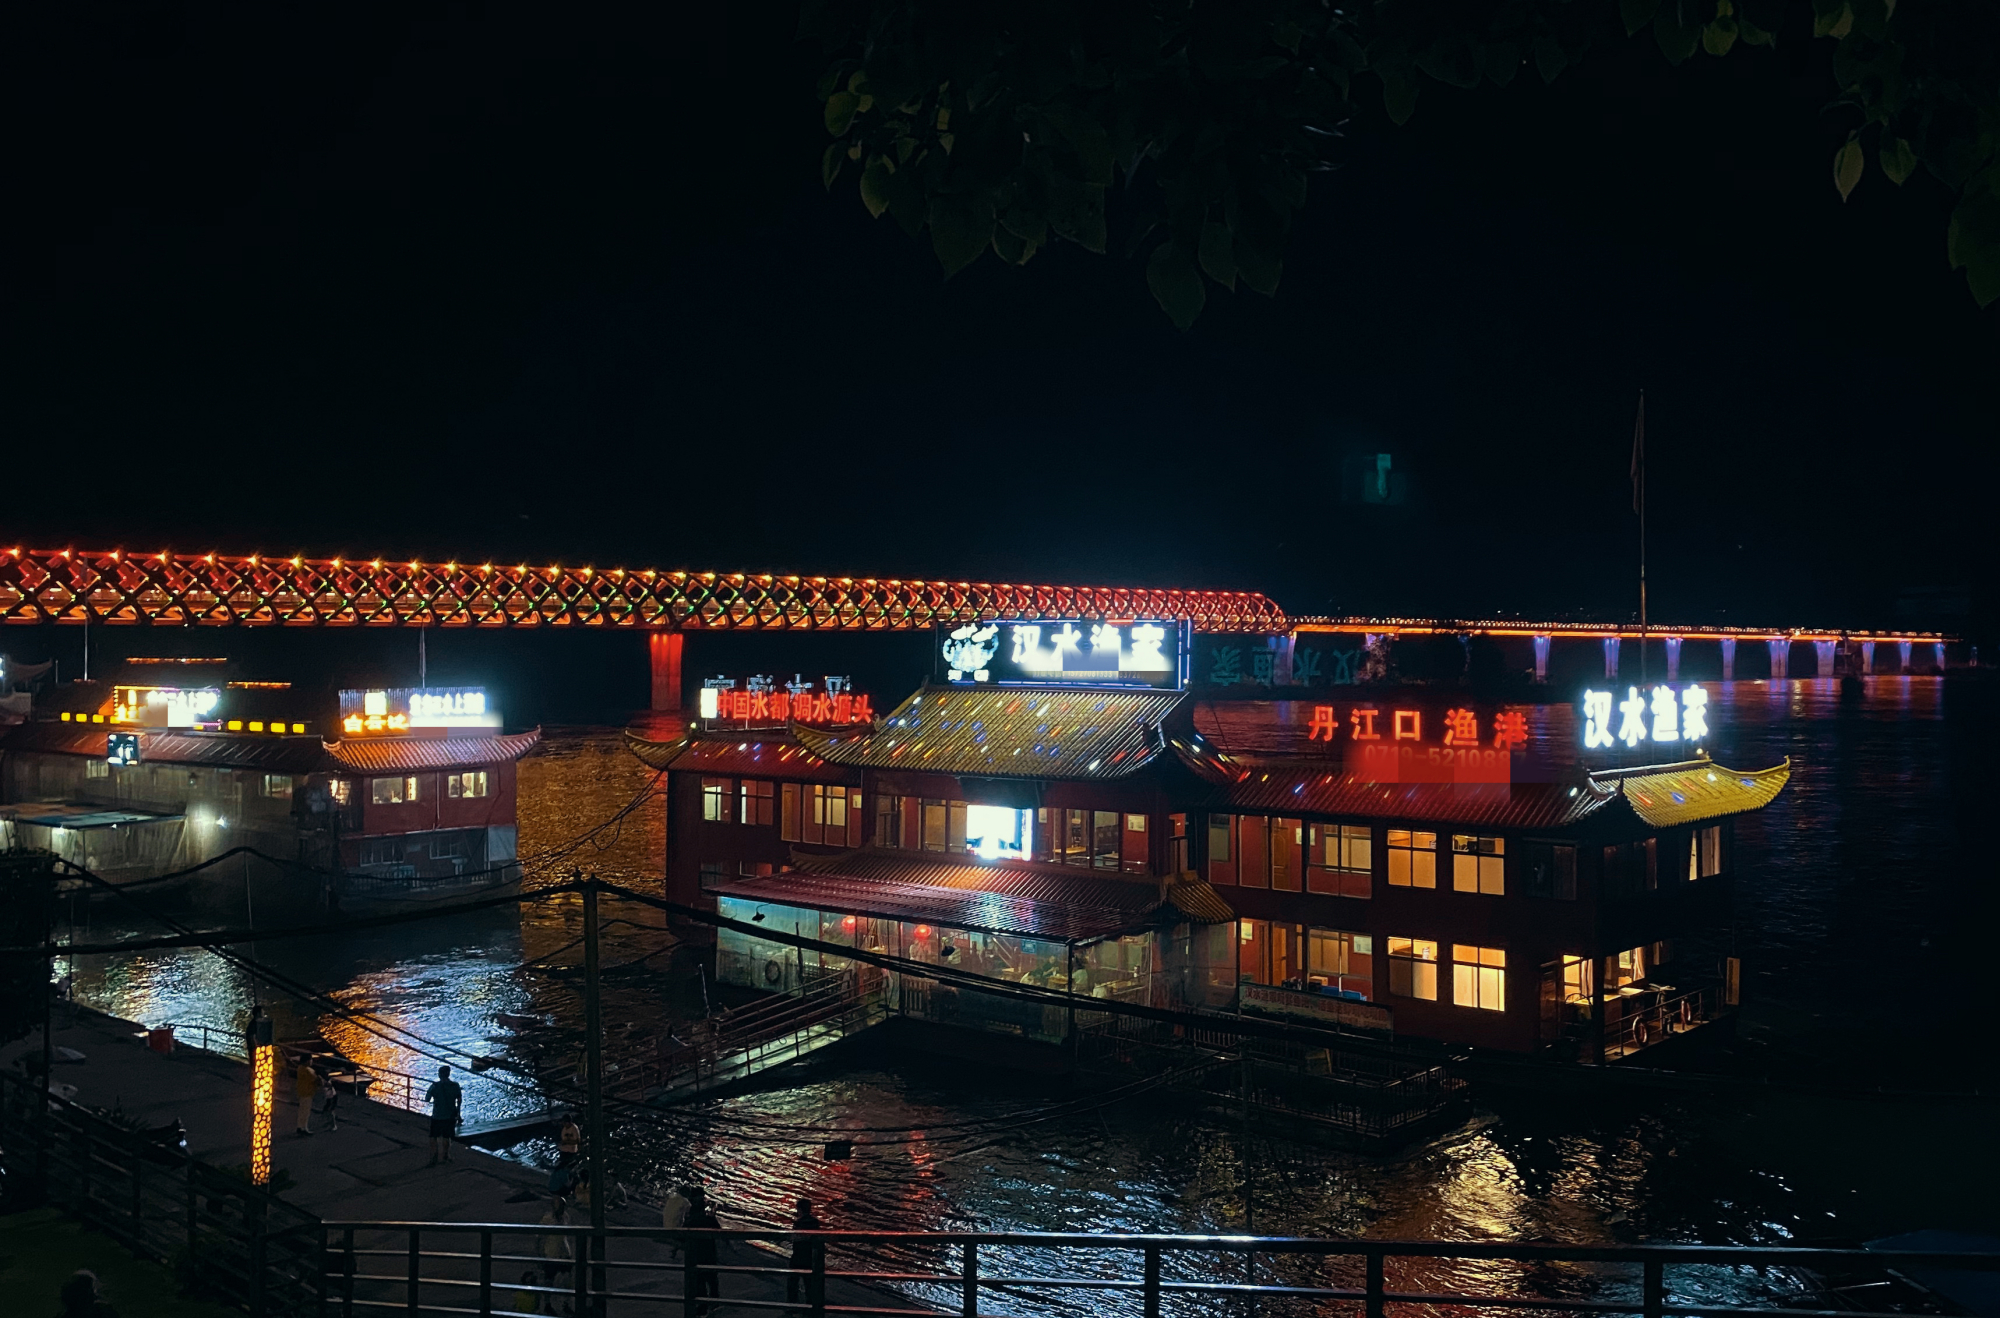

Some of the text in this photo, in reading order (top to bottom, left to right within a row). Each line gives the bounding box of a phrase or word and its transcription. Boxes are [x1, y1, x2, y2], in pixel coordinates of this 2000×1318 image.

[1308, 705, 1529, 749] 丹江口渔港
[1583, 684, 1709, 748] 汉水渔家
